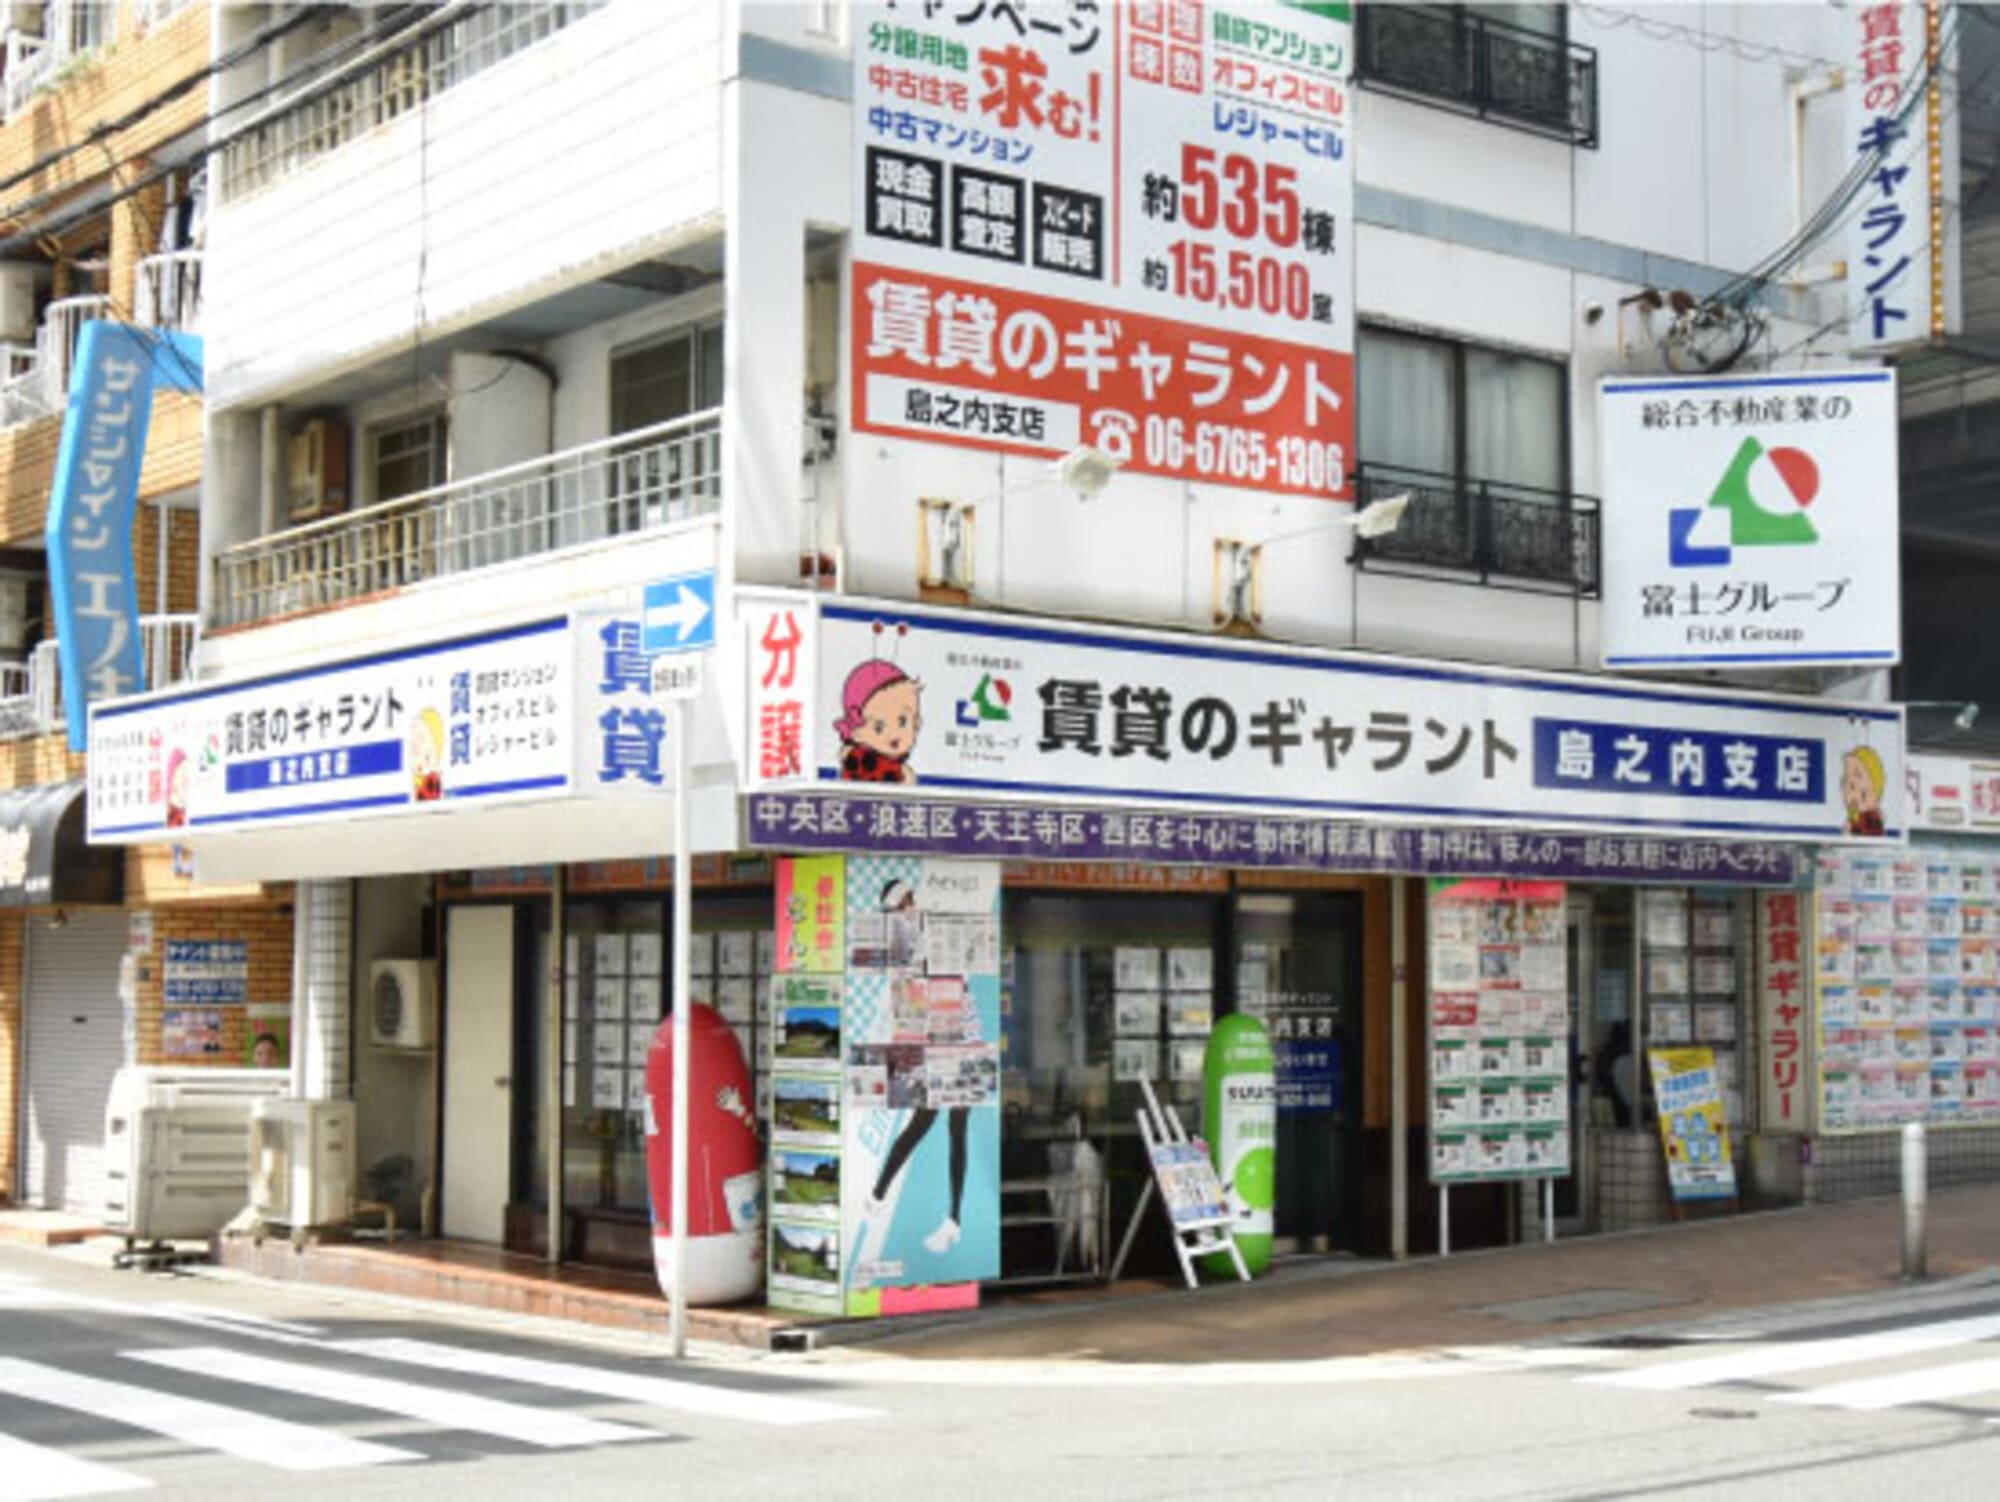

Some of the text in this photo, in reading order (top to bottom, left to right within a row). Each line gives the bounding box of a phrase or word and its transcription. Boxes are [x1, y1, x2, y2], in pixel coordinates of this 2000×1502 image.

[868, 21, 969, 72] 分譲用地
[868, 64, 969, 113] 中古住宅
[1213, 56, 1344, 115] オフィスビル
[868, 104, 1034, 164] 中古マンション
[1213, 100, 1344, 160] レジャービル
[875, 157, 934, 200] 現金
[864, 279, 1342, 428] 賃貸のギャラント
[905, 388, 1047, 441] 島之内支店
[1642, 395, 1852, 430] 総合不動産業の
[1144, 414, 1345, 493] 06-6765-1306
[1641, 578, 1852, 618] 富士グループ
[1740, 624, 1805, 645] Group
[225, 686, 403, 756] 賃貸のギャラント
[599, 619, 667, 785] 賃貸
[760, 610, 803, 779] 分譲
[1036, 677, 1520, 780] 賃貸のギャラント
[1556, 730, 1811, 793] 島之内支店
[1767, 893, 1800, 1119] 賃貸ギャラリー
